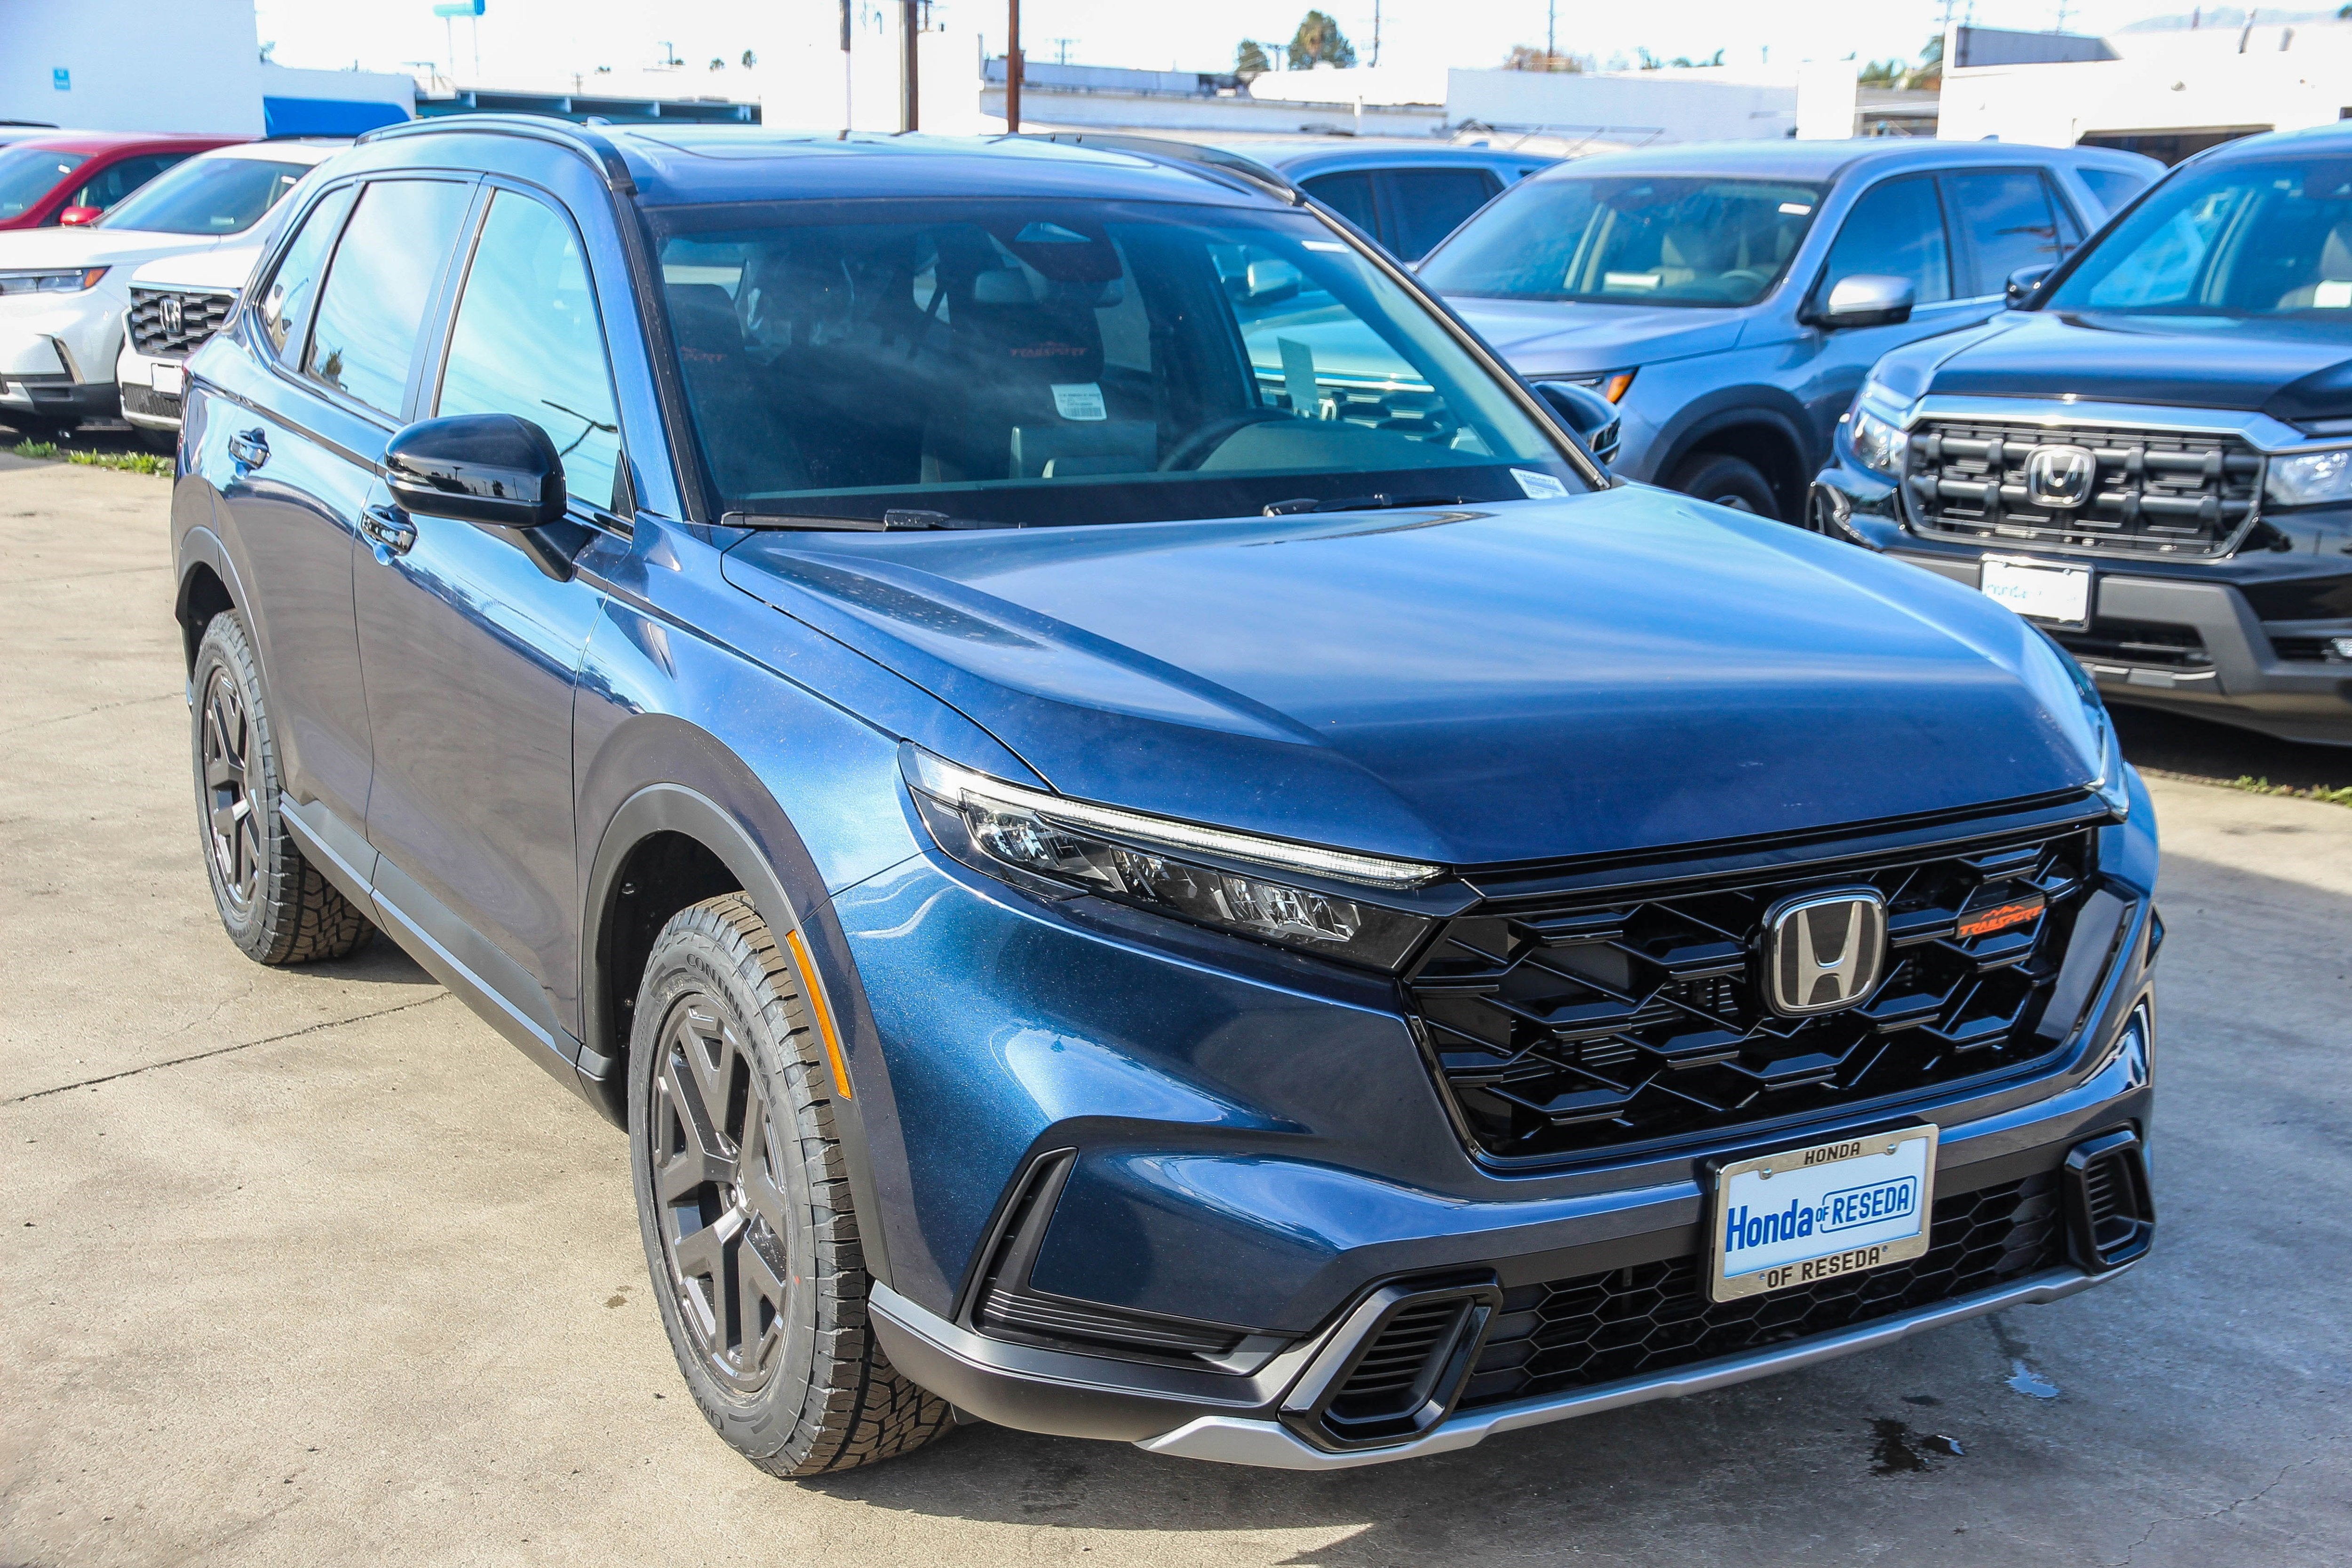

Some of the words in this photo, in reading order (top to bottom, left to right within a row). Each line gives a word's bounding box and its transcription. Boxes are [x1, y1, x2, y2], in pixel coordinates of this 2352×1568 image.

[1804, 1141, 1861, 1165] HONDA
[1725, 1198, 1812, 1253] Honda
[1816, 1205, 1829, 1223] OF
[1831, 1184, 1909, 1225] RESEDA
[1767, 1266, 1793, 1289] OF
[1802, 1246, 1881, 1282] RESEDA
